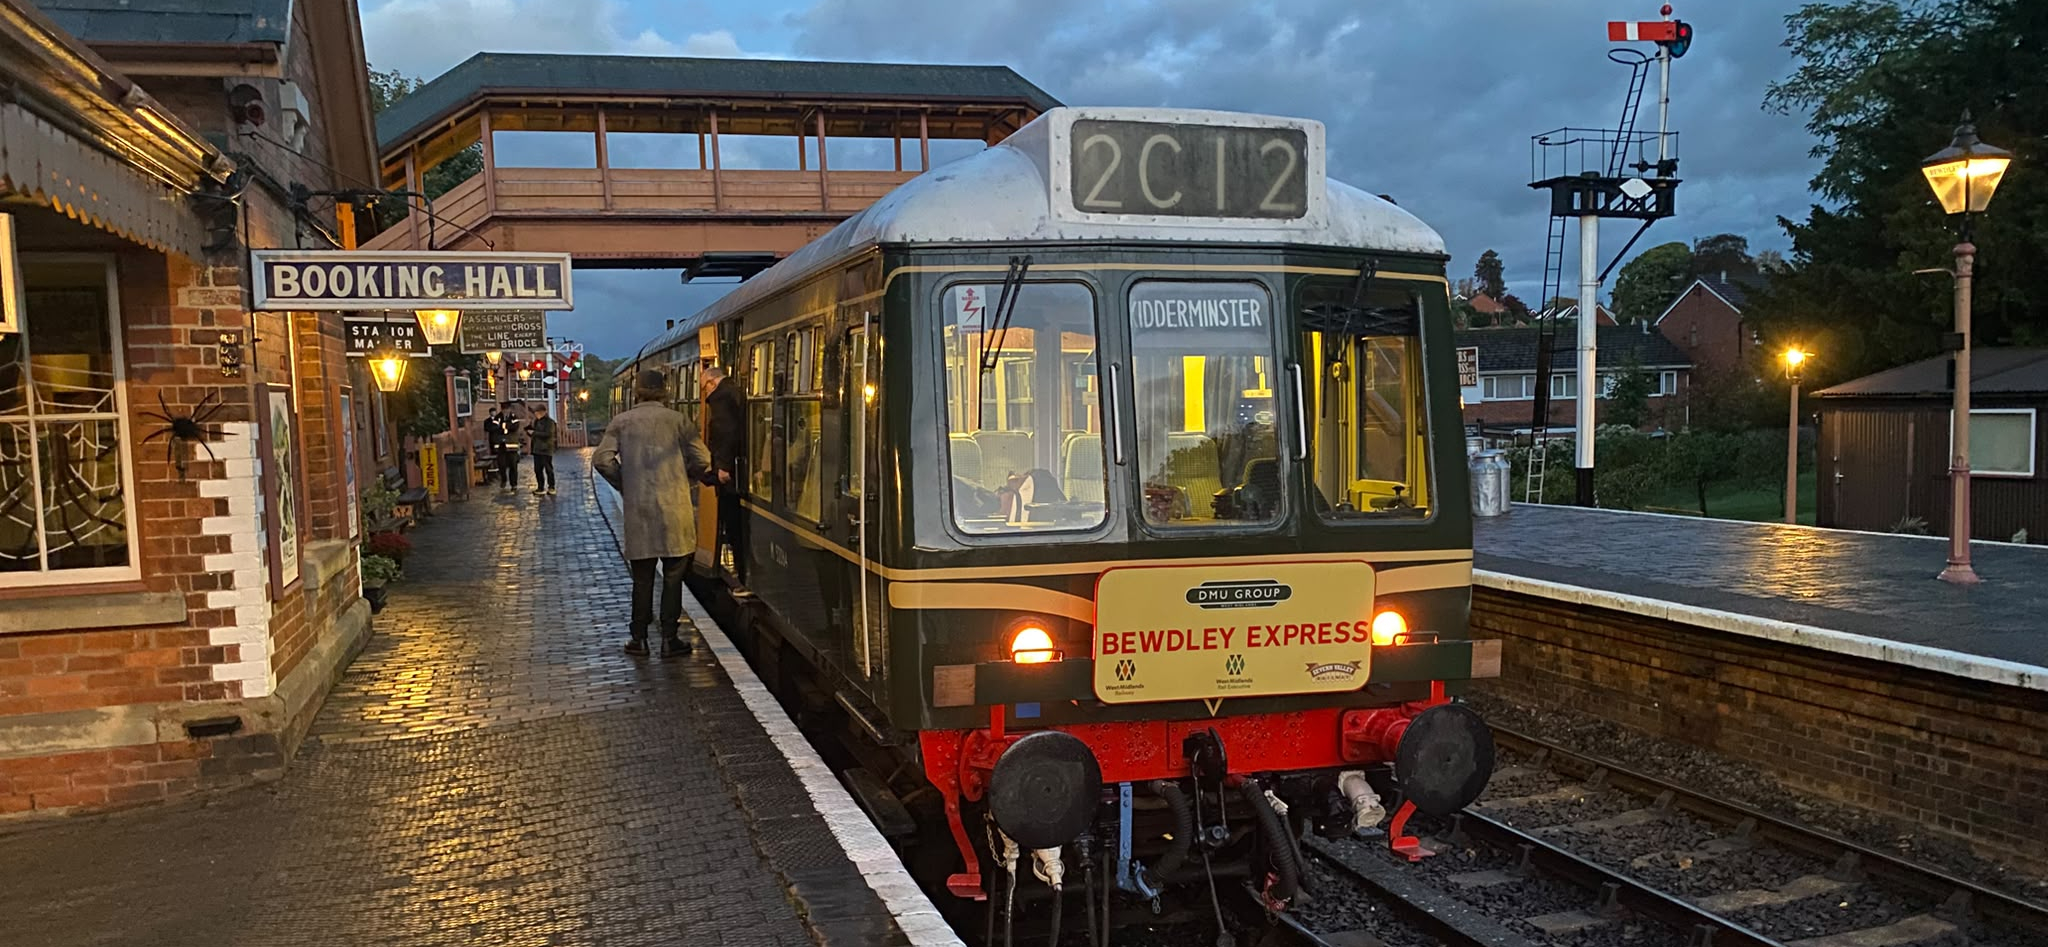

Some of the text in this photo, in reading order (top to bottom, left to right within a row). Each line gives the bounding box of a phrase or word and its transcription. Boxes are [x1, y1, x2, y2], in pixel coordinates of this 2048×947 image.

[1083, 133, 1298, 212] 2C12
[273, 264, 557, 298] BOOKING HALL
[463, 313, 526, 323] PASSENGERS
[352, 326, 414, 337] STAION
[511, 322, 542, 332] CROSS
[487, 331, 510, 341] LINE
[354, 338, 412, 349] MAER
[500, 338, 538, 349] BRIDGE
[425, 447, 434, 486] TIZER
[1198, 587, 1281, 601] DMU GROUP
[1102, 621, 1369, 655] BEWDLEY EXPRESS
